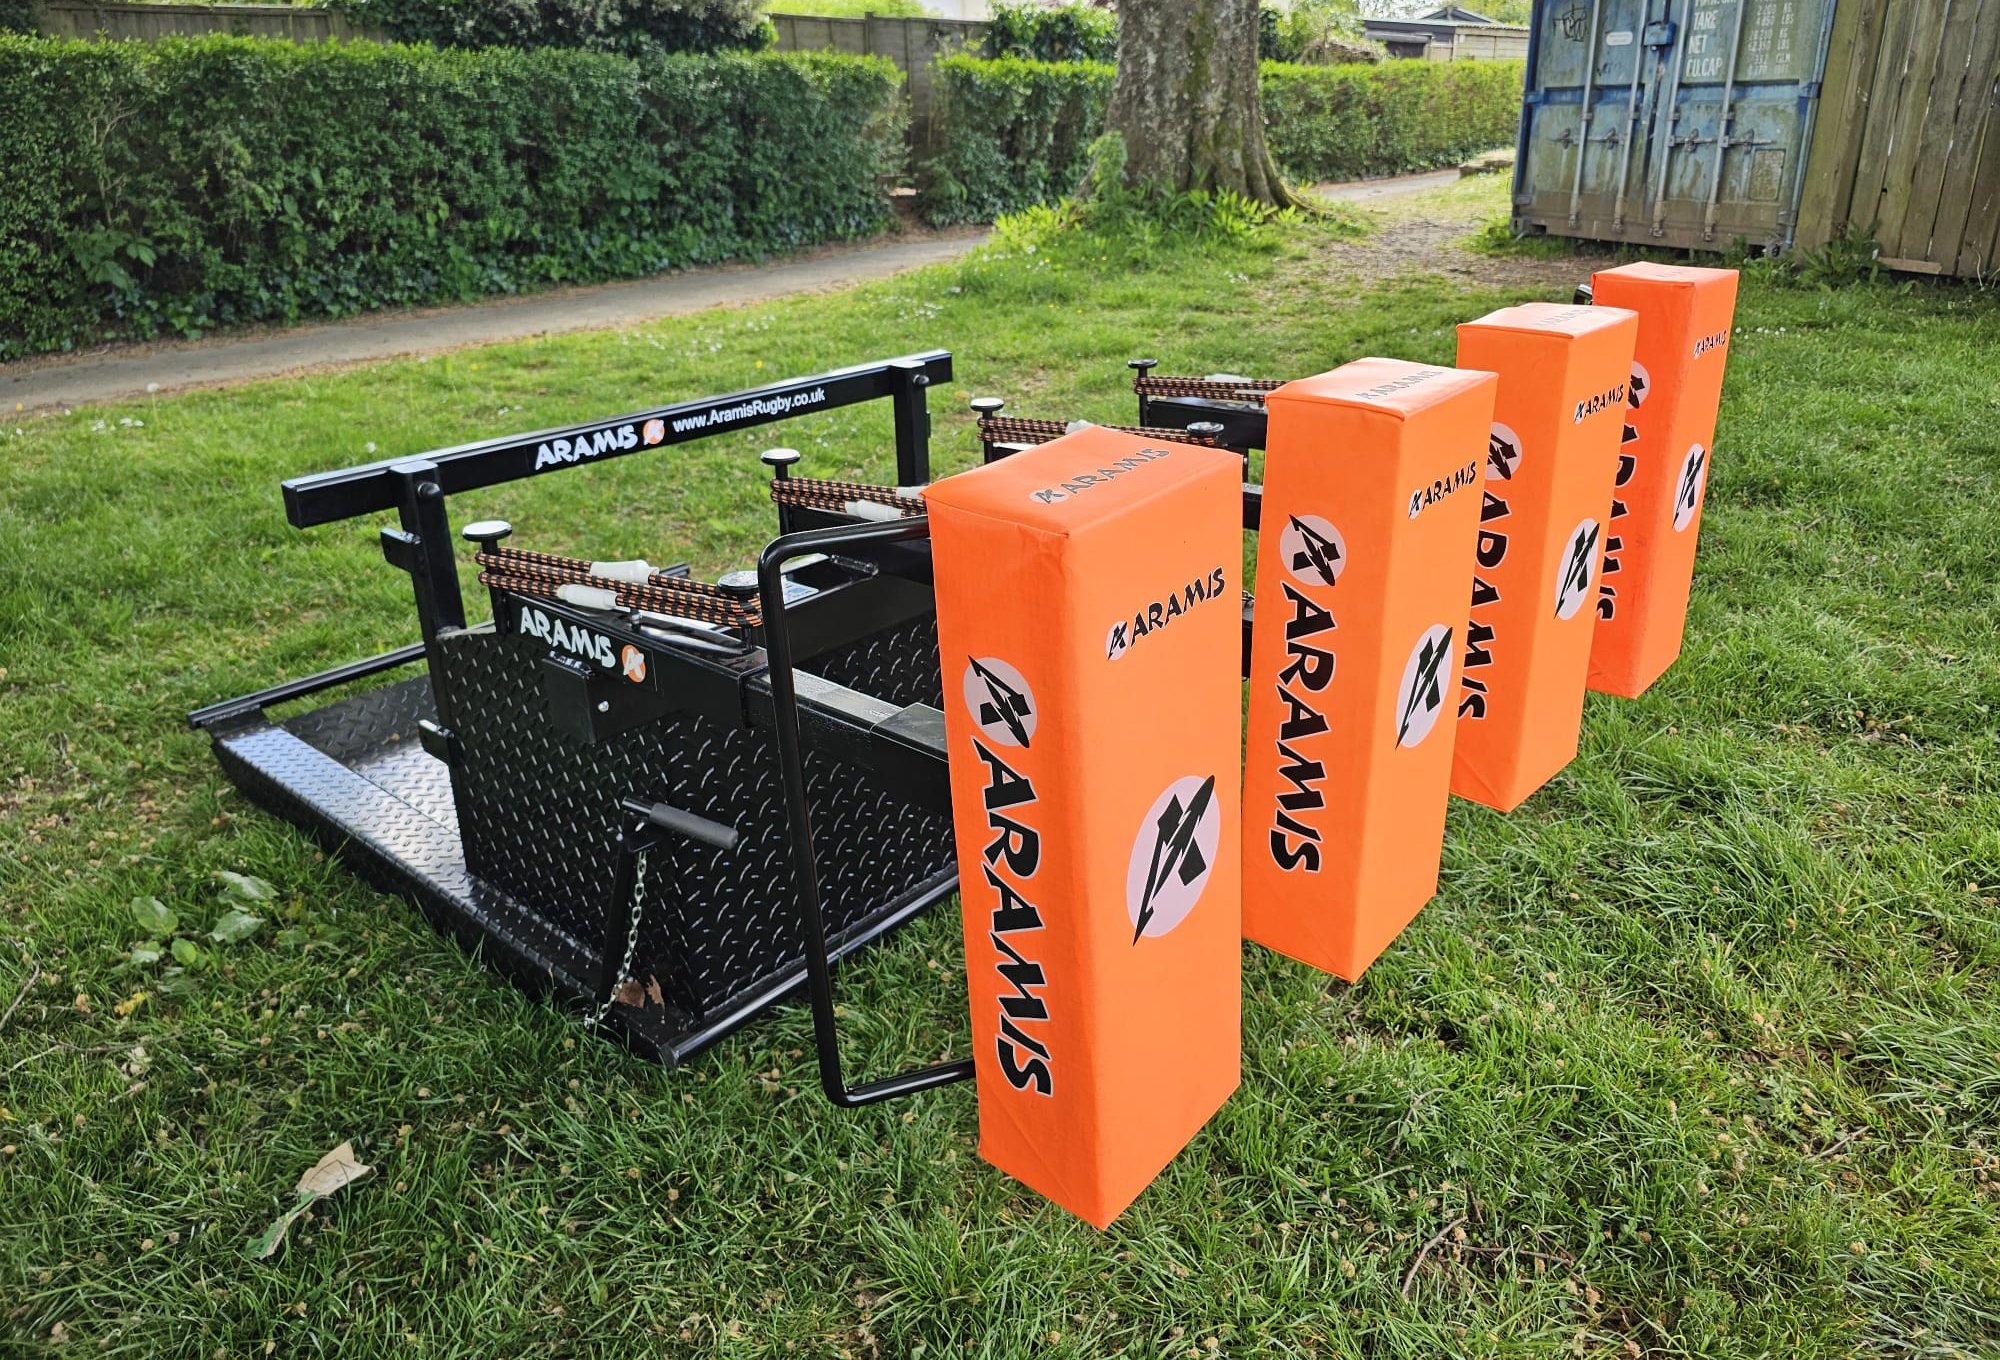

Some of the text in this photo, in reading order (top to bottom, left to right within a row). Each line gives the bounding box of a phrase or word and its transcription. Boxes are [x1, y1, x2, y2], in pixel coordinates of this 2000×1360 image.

[1688, 34, 1708, 54] NET
[1694, 10, 1719, 30] TARE
[535, 387, 826, 470] ARAMIS www.AramisRugby.co.uk
[1584, 384, 1624, 419] ARAMIS
[1060, 447, 1171, 496] ARAMIS
[1422, 460, 1477, 509] ARAMIS
[1130, 566, 1226, 647] ARAMIS
[520, 606, 616, 668] ARAMIS
[1268, 581, 1337, 873] ARAMIS
[971, 738, 1053, 1097] ARAMIS
